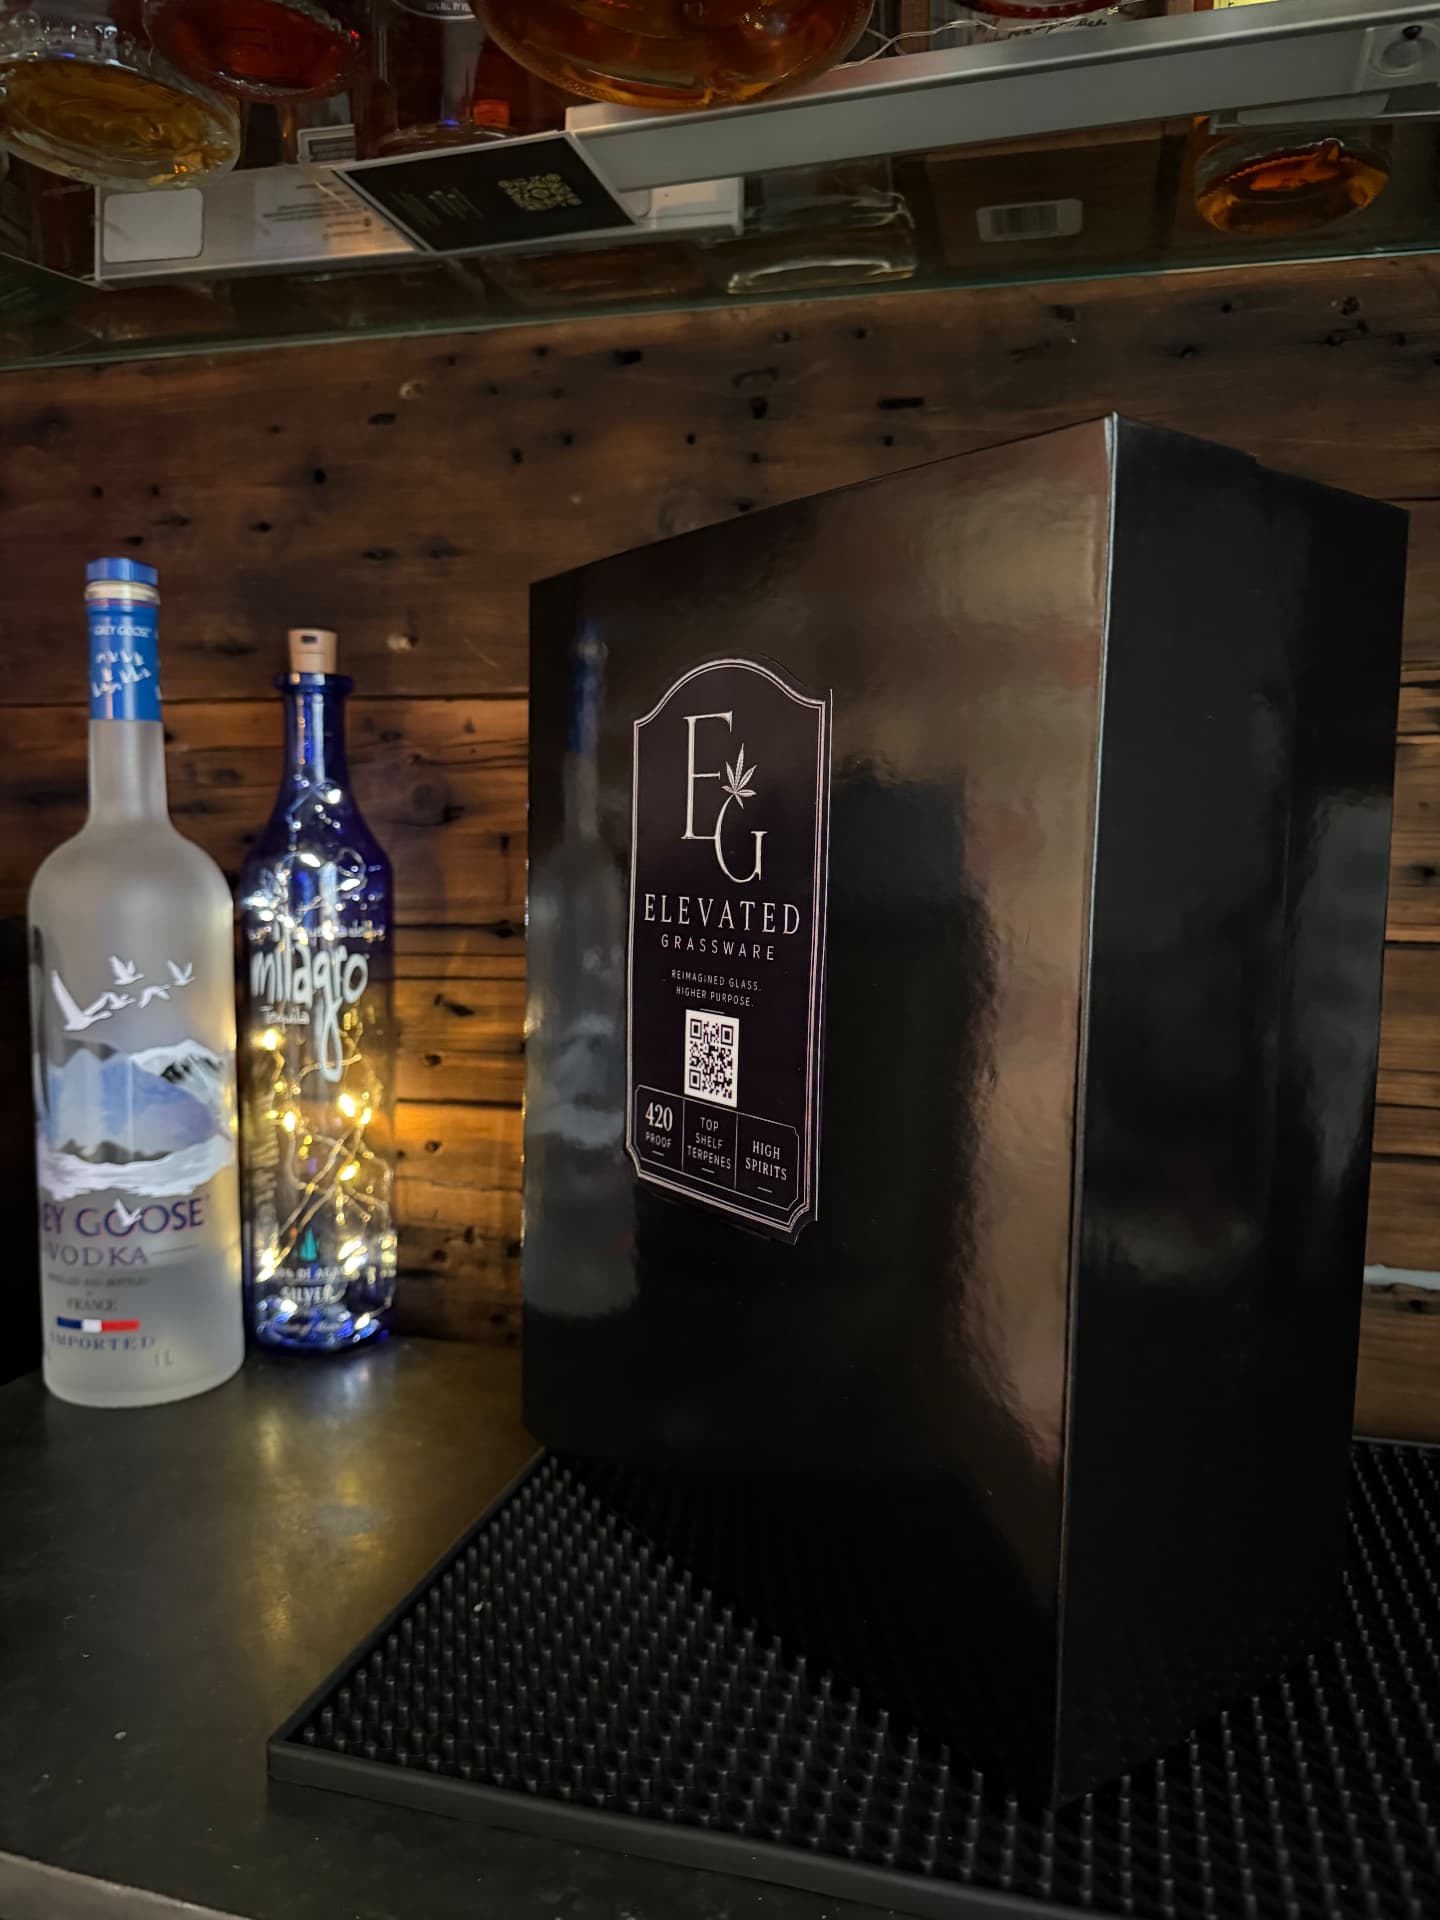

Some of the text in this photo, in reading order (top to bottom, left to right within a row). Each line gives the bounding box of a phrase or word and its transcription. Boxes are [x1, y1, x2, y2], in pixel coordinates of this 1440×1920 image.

[644, 893, 800, 935] ELEVATED
[661, 934, 775, 961] GRASSWARE
[671, 969, 725, 986] REIMAGINED
[676, 986, 707, 999] HIGHER
[645, 1102, 673, 1132] 420
[700, 1116, 719, 1132] TOP
[645, 1131, 672, 1149] PROOF
[695, 1132, 723, 1149] SHELF
[752, 1140, 781, 1161] HIGH
[687, 1145, 731, 1170] TERPENES
[745, 1157, 787, 1181] SPIRITS
[76, 1198, 203, 1238] GOOSE
[48, 1243, 149, 1267] VODKA
[51, 1331, 155, 1351] IMPORTED
